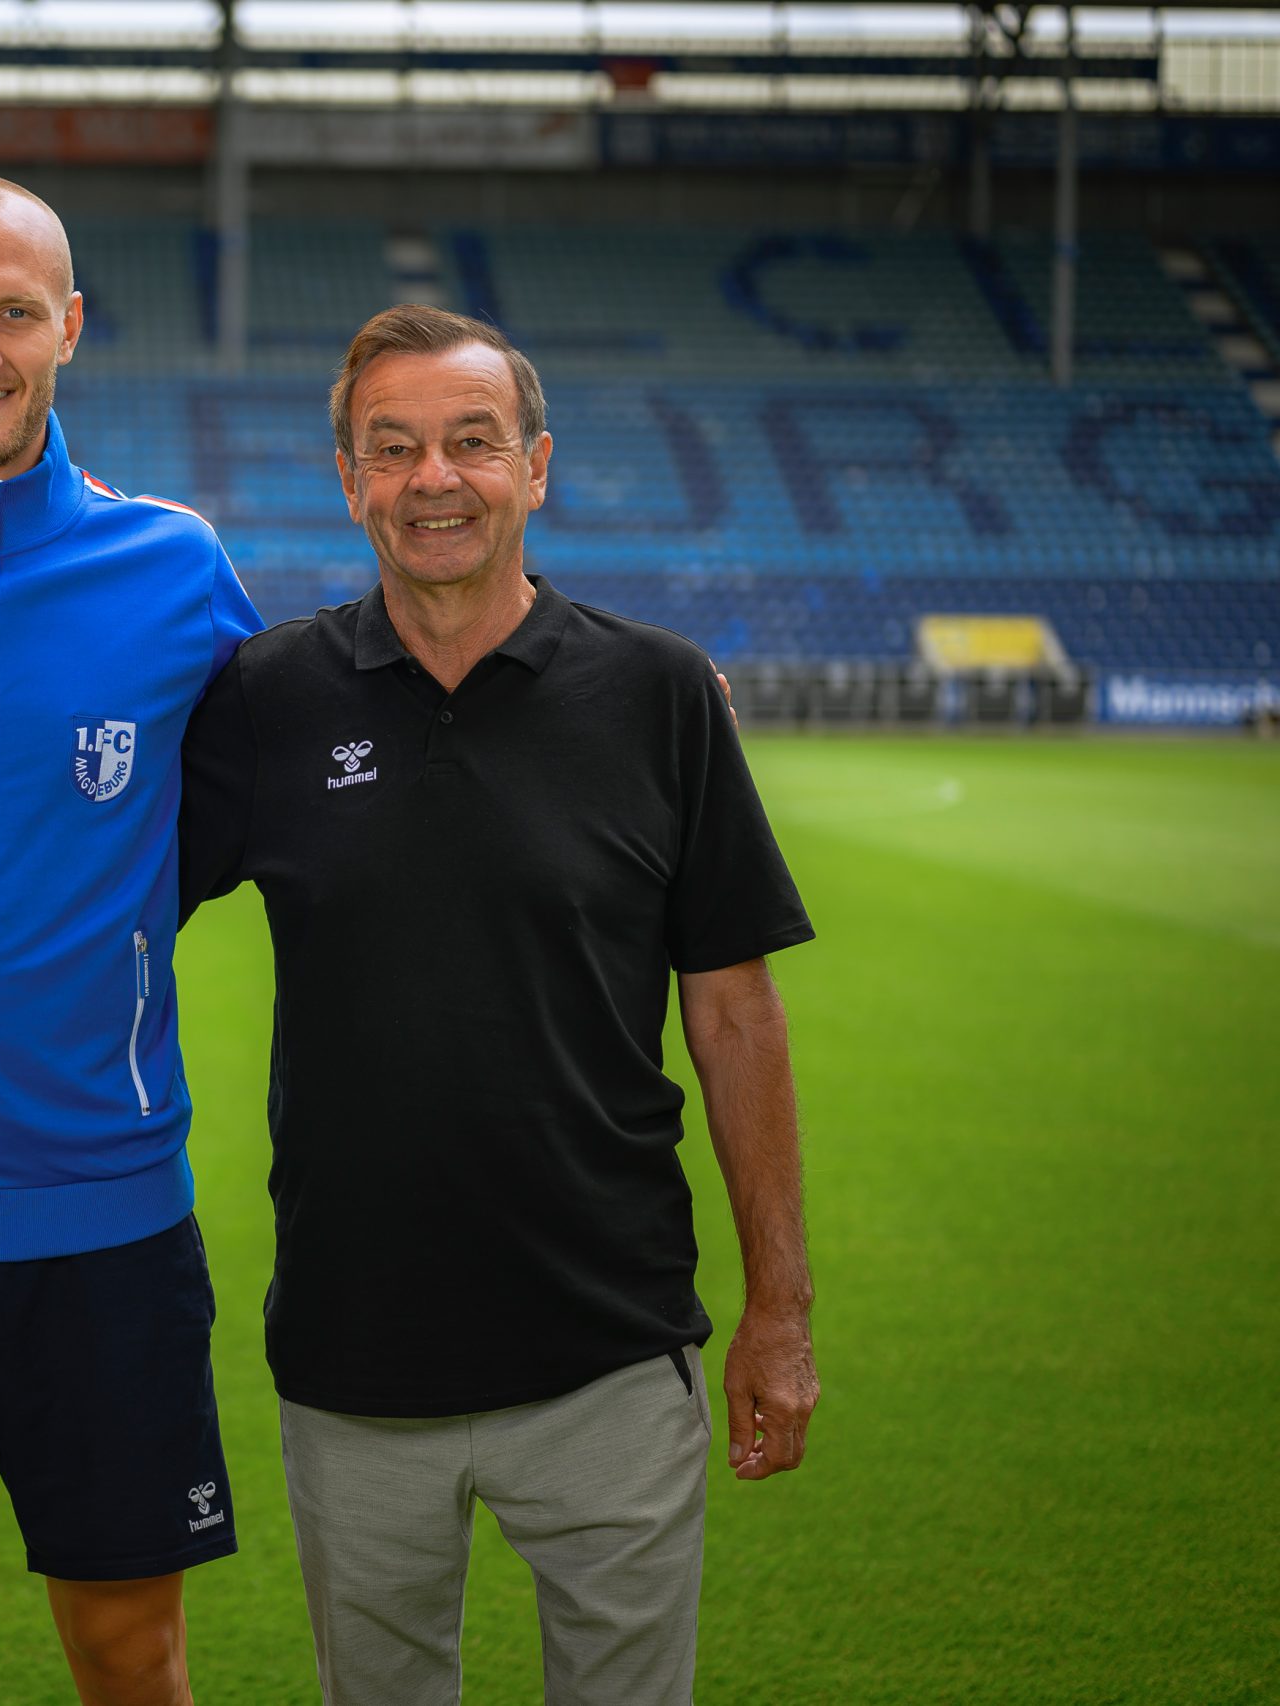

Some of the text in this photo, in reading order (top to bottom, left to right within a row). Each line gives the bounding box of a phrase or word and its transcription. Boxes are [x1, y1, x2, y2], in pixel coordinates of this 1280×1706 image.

[76, 727, 132, 754] 1.FC
[75, 757, 128, 797] MAGDEBURG
[327, 767, 377, 790] hummel
[188, 1509, 225, 1533] hummel
